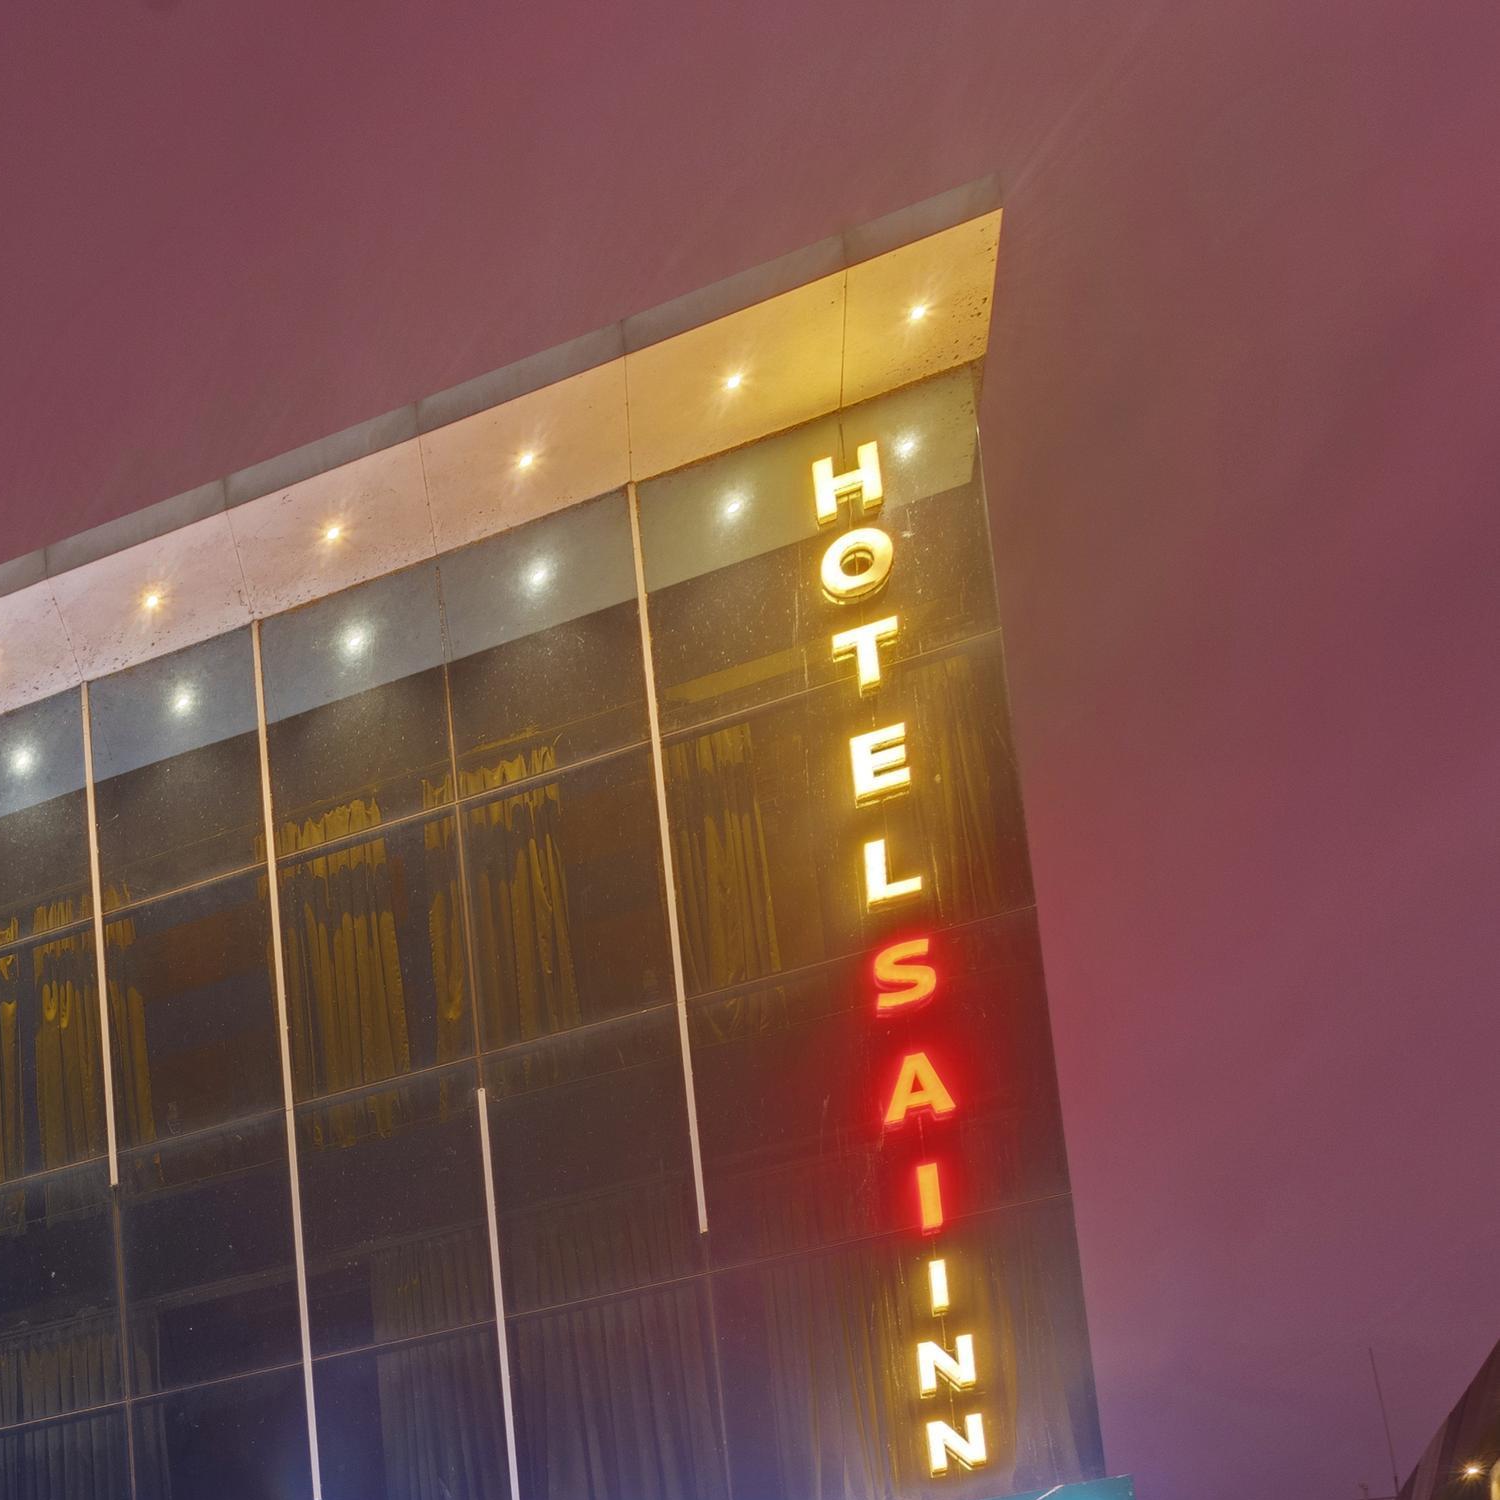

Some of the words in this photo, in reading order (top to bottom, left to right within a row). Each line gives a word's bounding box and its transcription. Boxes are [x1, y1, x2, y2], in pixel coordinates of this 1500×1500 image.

[812, 441, 922, 913] HOTEL
[873, 938, 957, 1236] SAI
[916, 1259, 987, 1479] INN
